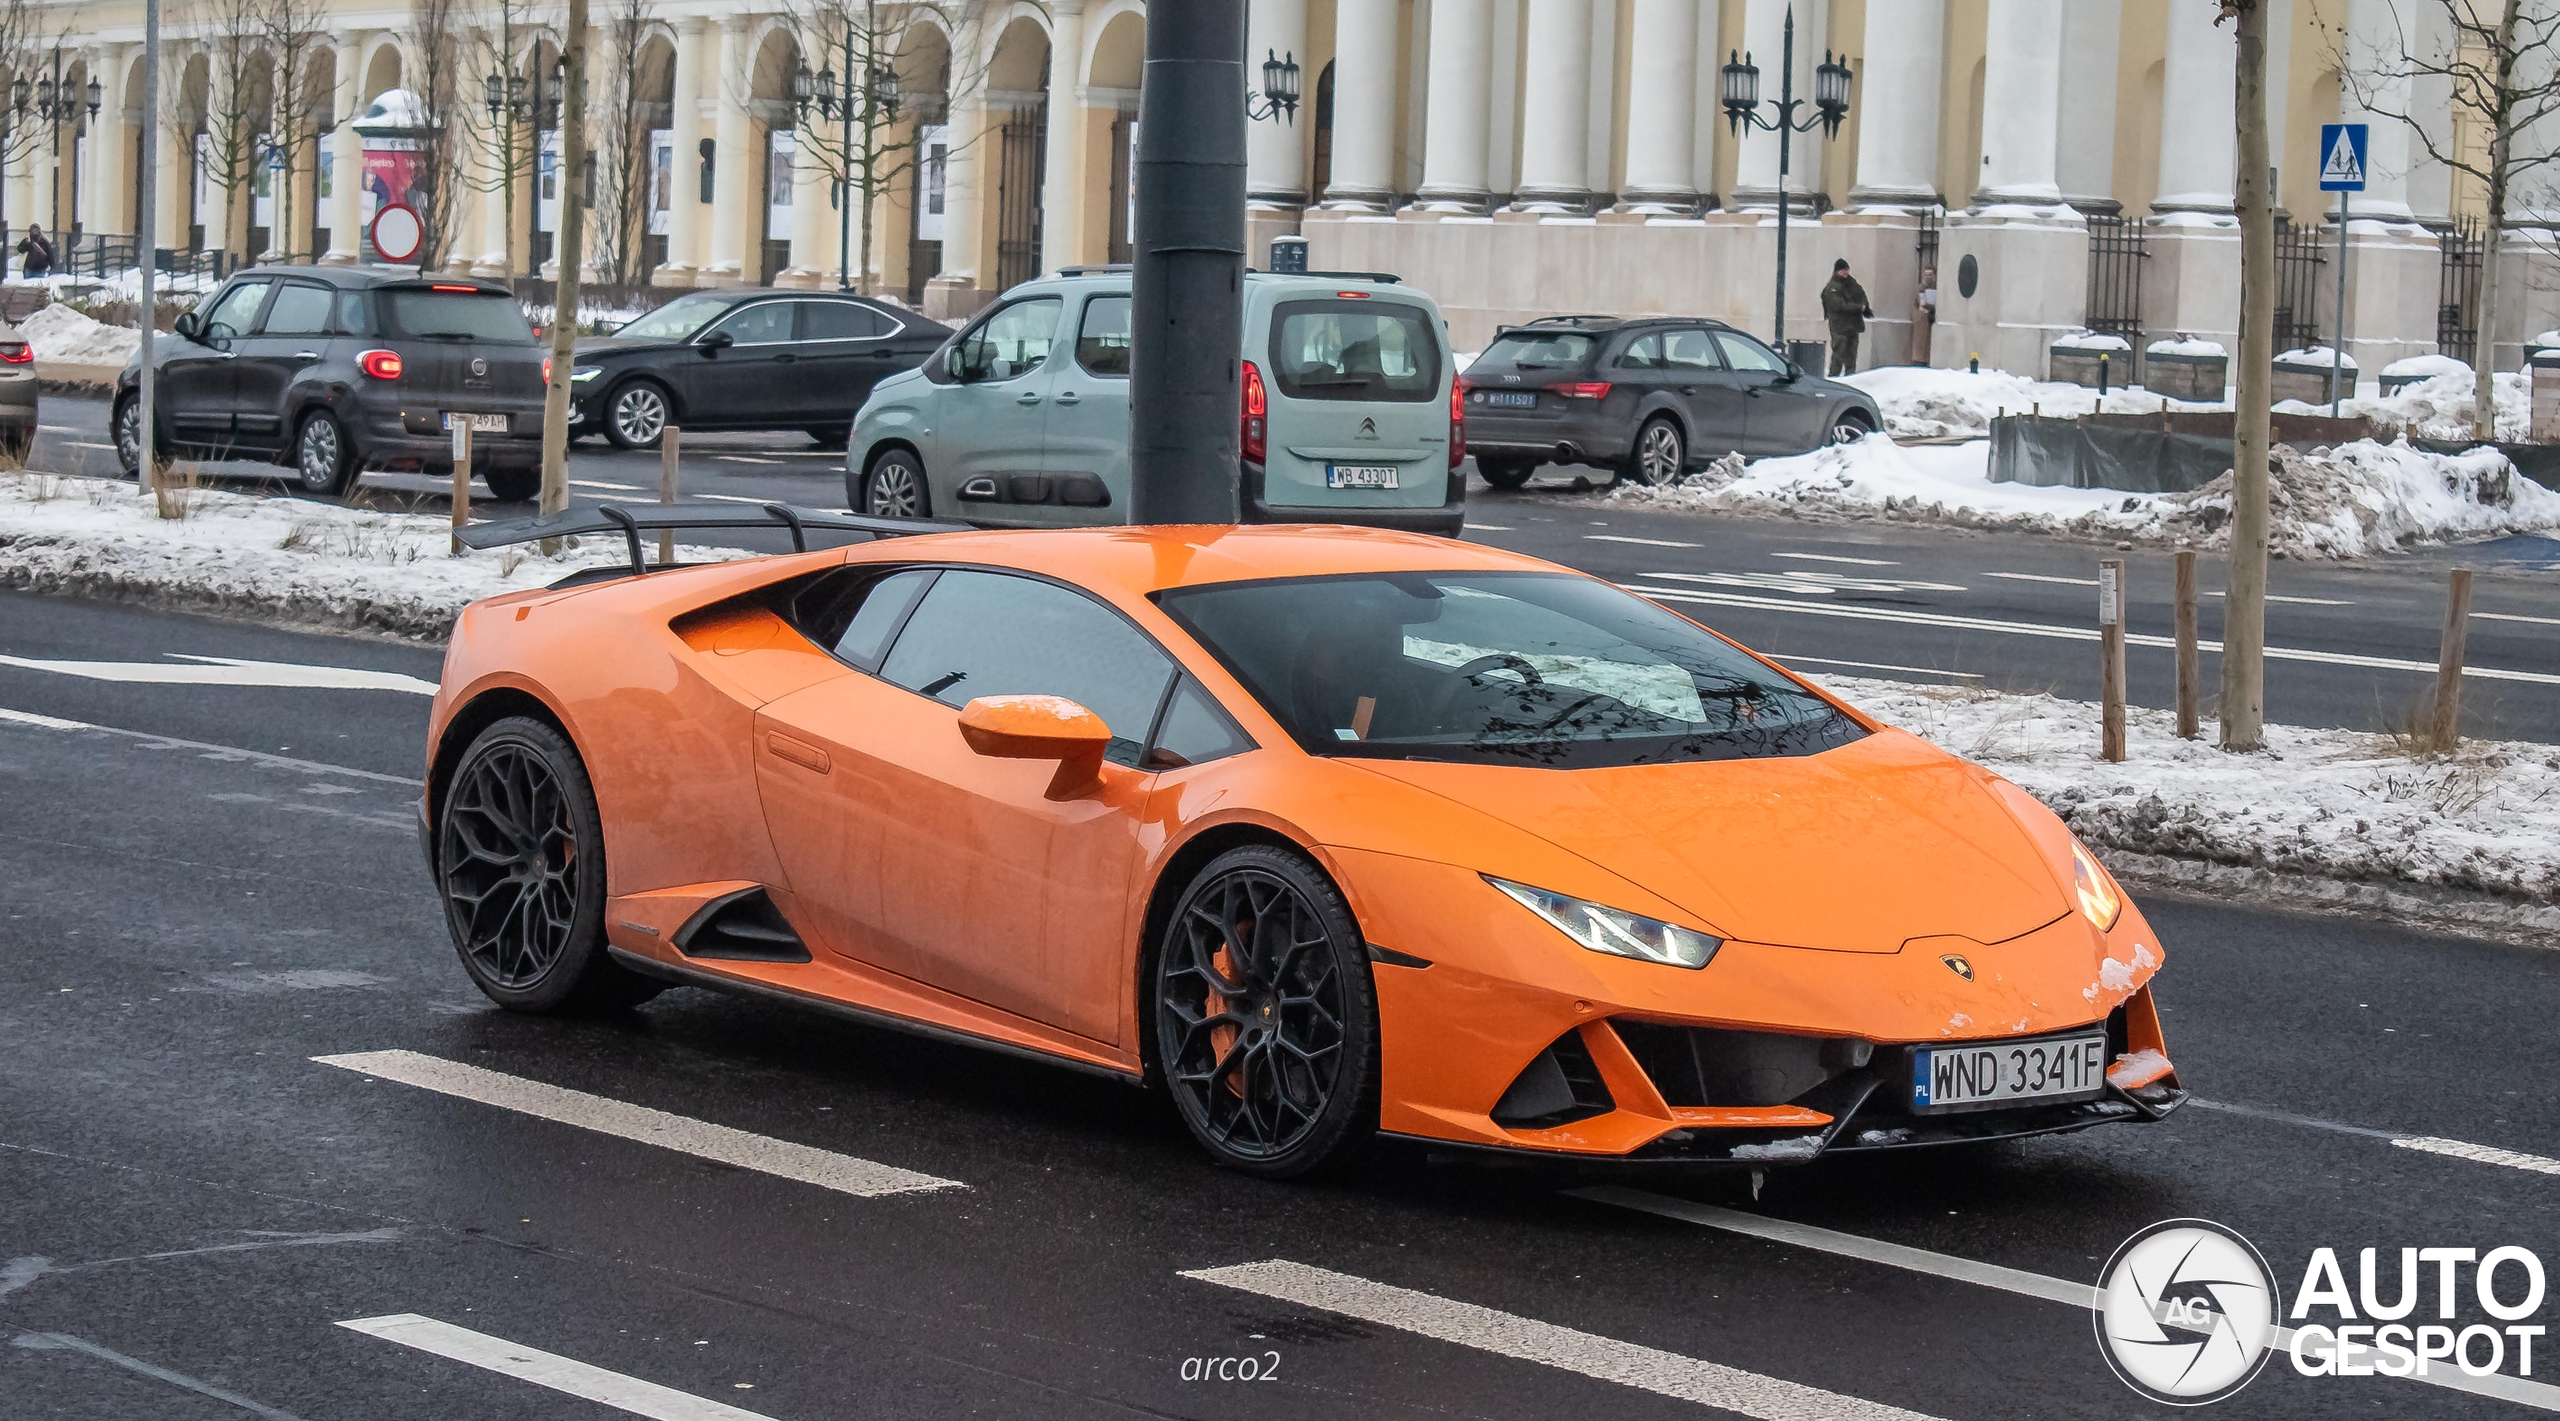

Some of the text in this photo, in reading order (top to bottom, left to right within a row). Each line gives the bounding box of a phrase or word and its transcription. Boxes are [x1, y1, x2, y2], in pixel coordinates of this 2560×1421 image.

[1337, 468, 1353, 484] WB
[1358, 468, 1395, 485] 4330T
[1934, 1041, 2102, 1100] WND 3341F
[1915, 1085, 1928, 1097] PL
